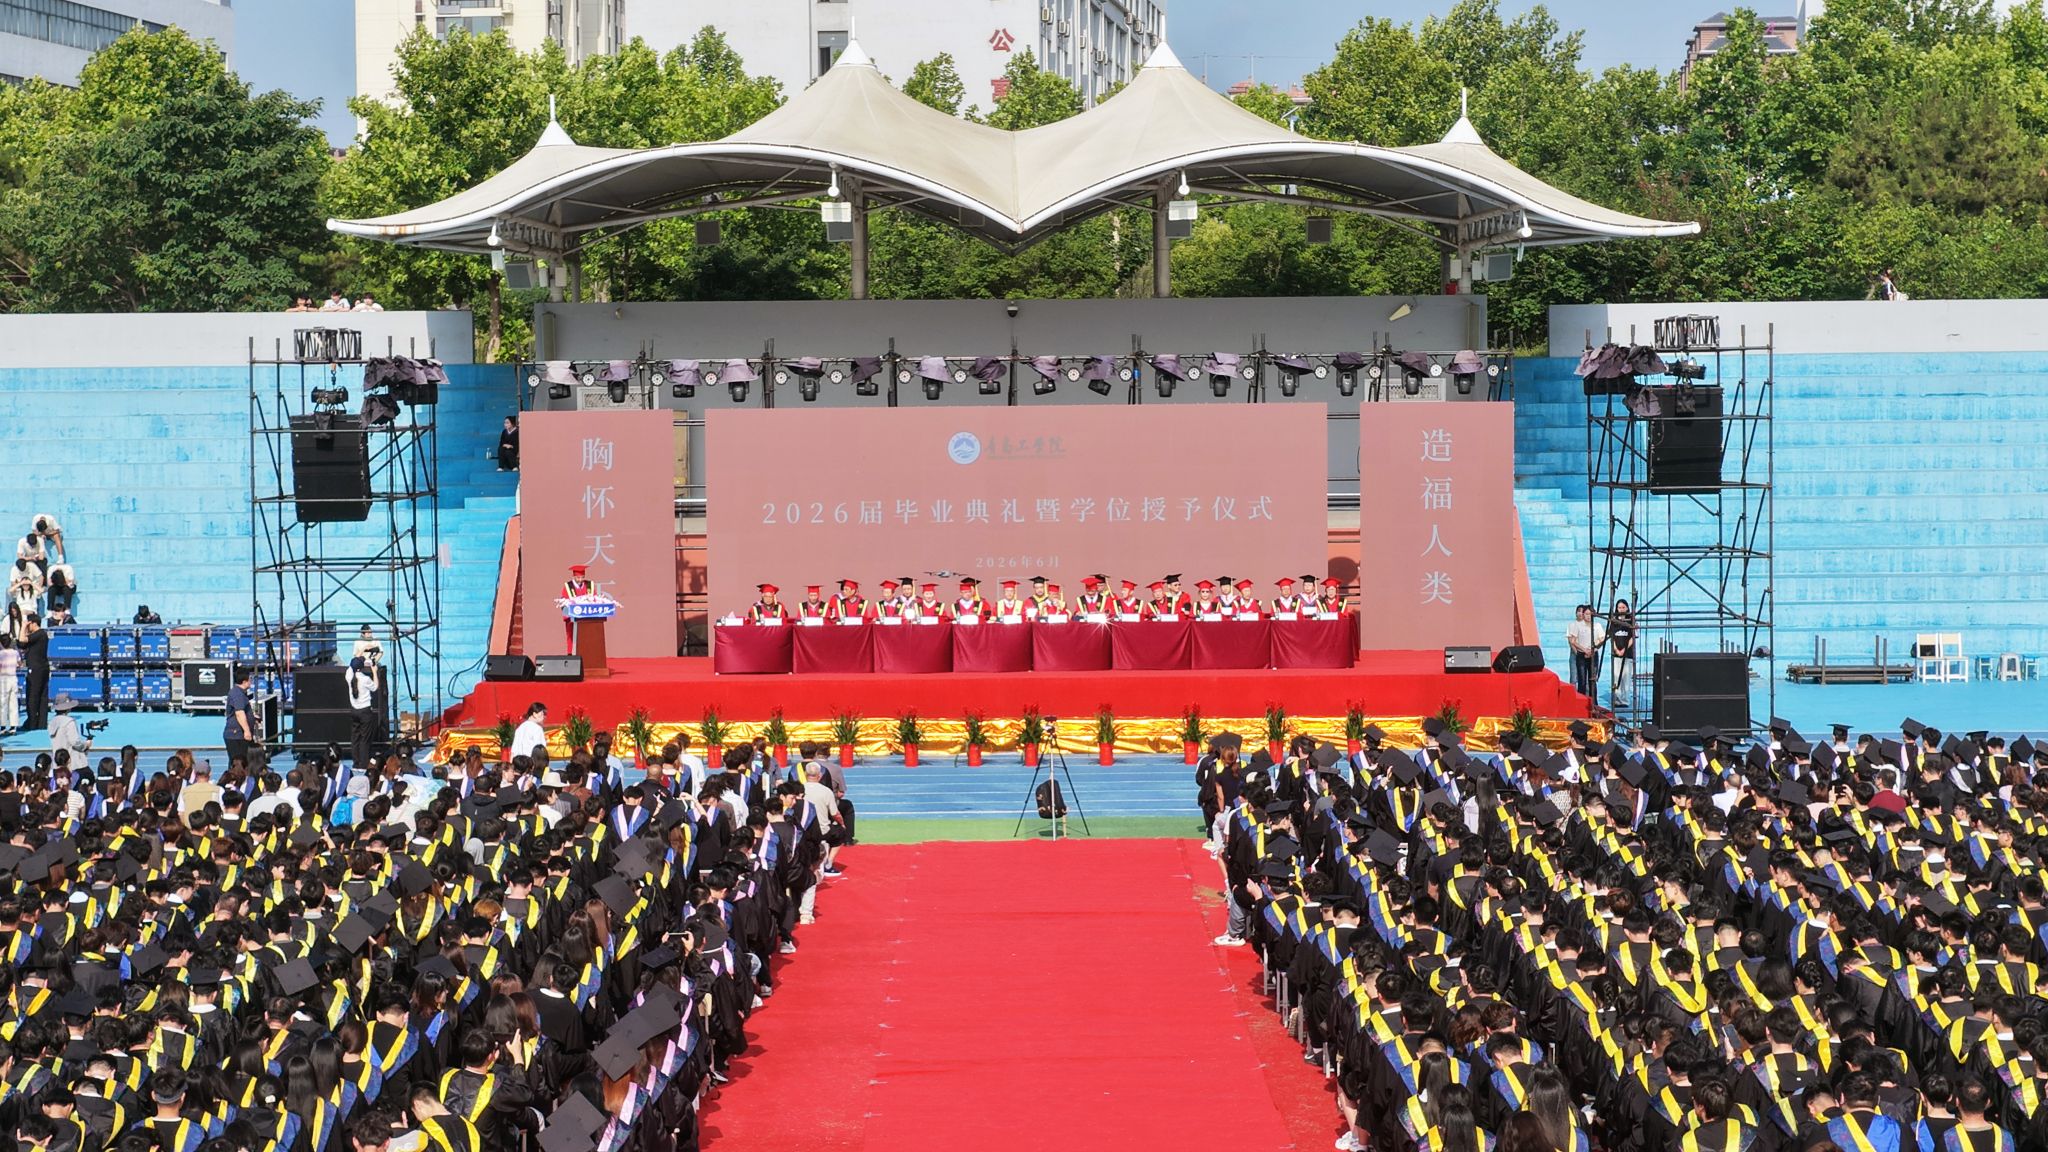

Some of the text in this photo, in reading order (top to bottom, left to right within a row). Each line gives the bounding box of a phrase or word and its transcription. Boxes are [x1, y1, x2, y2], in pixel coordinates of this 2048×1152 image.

[762, 496, 1273, 525] 2026届毕业典礼暨学位授予仪式
[1420, 428, 1453, 605] 造福人类
[975, 555, 1060, 568] 2026年6月
